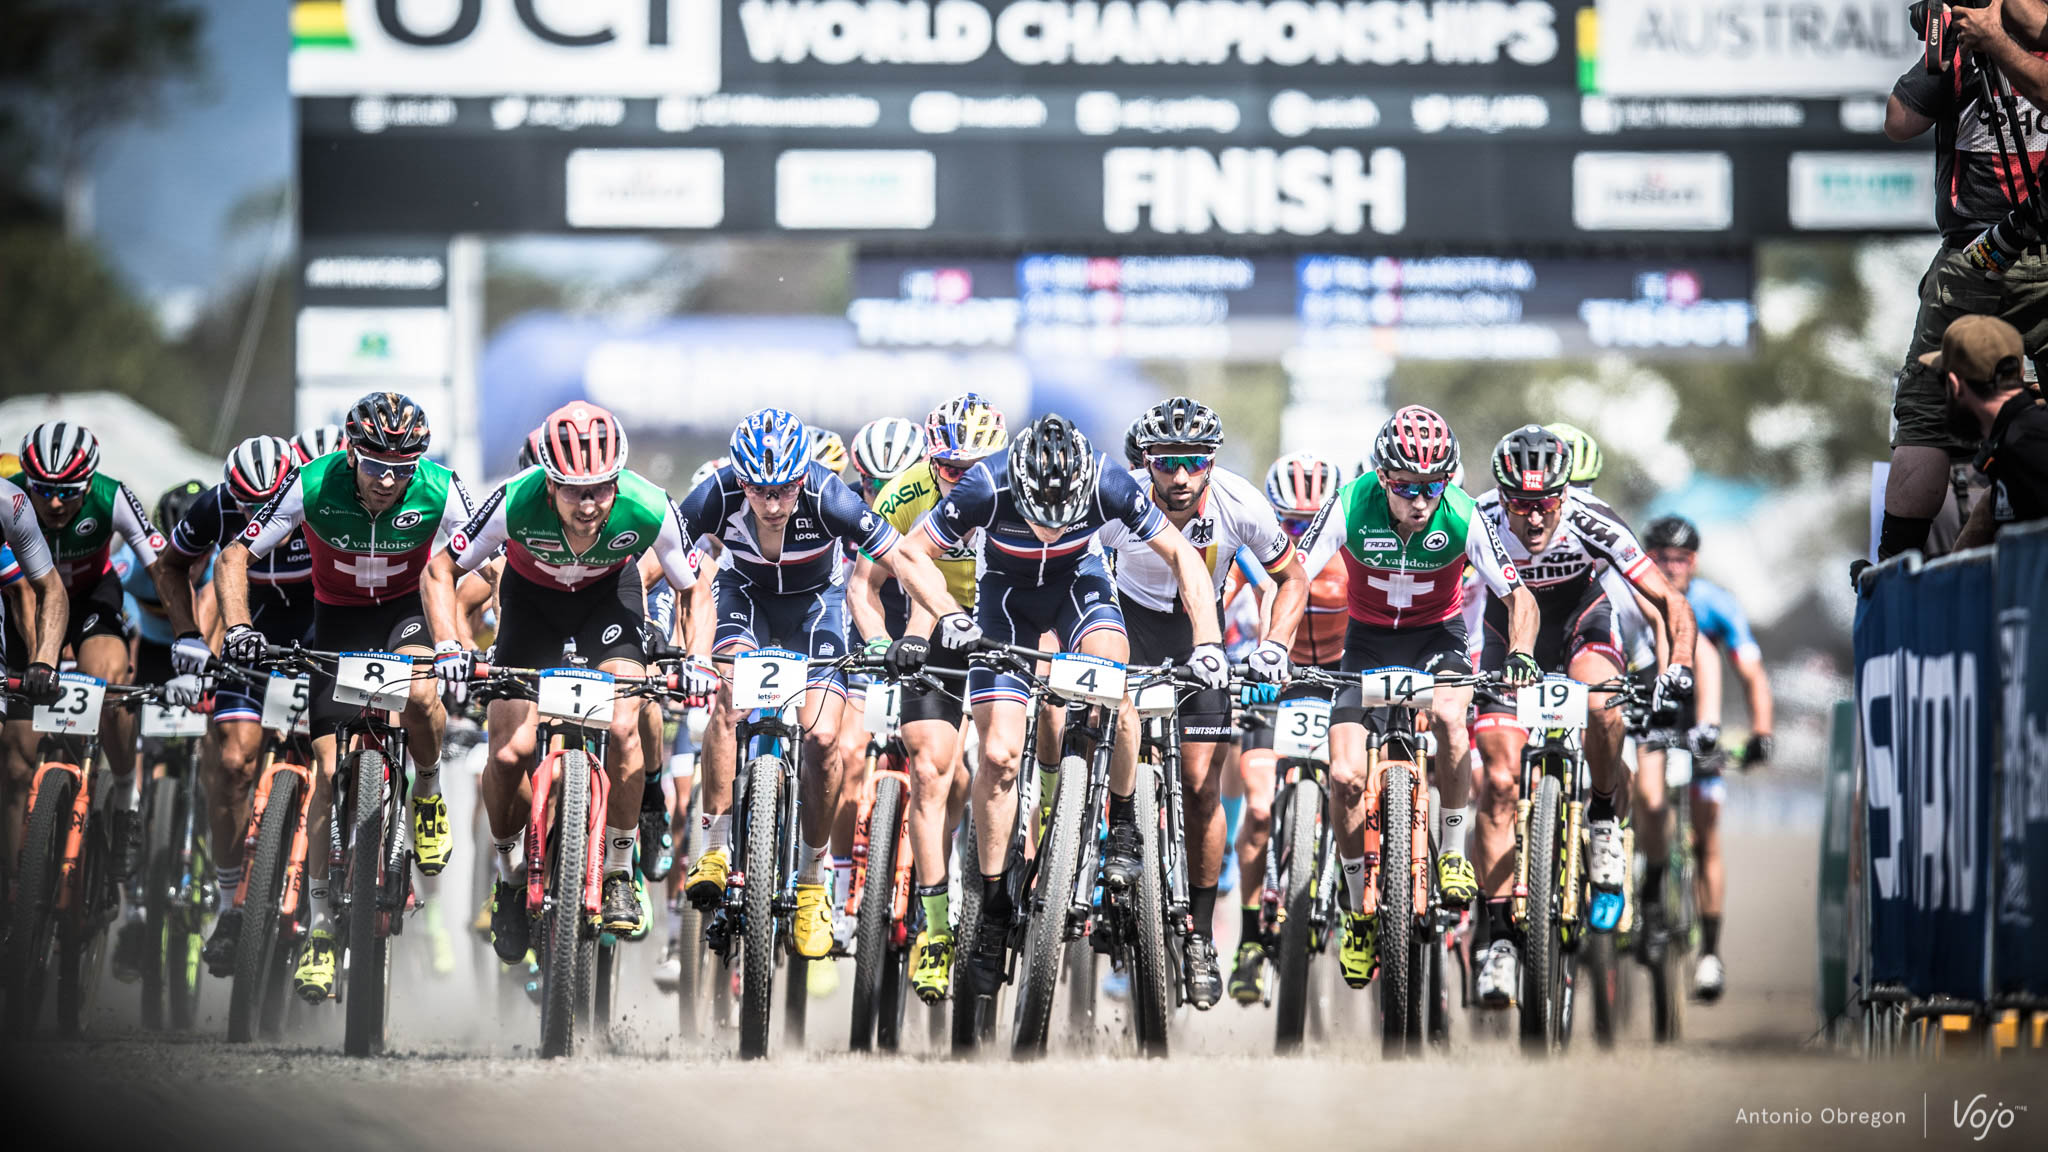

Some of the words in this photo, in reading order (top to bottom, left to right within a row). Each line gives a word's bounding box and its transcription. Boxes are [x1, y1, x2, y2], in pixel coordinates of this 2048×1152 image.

[739, 0, 992, 65] WORLD
[996, 0, 1559, 65] CHAMPIONSHIPS
[1930, 18, 1939, 46] Canon
[1103, 147, 1405, 235] FINISH
[878, 481, 931, 523] RASIL
[795, 533, 821, 541] LOOK
[1062, 520, 1089, 533] OOK
[1567, 508, 1620, 549] KTM
[353, 540, 415, 550] vaudoise
[1384, 556, 1443, 569] vaudoise
[352, 652, 401, 661] SHIMANO
[748, 649, 796, 660] SHIMANO
[1066, 653, 1115, 667] SHIMANO
[363, 662, 385, 684] 8
[553, 669, 603, 680] SHIMANO
[759, 661, 780, 689] 2
[1075, 668, 1098, 692] 4
[47, 685, 90, 715] 23
[289, 682, 310, 713] 5
[570, 683, 582, 714] 1
[1380, 674, 1416, 702] 14
[1535, 684, 1570, 708] 19
[1290, 712, 1329, 739] 35
